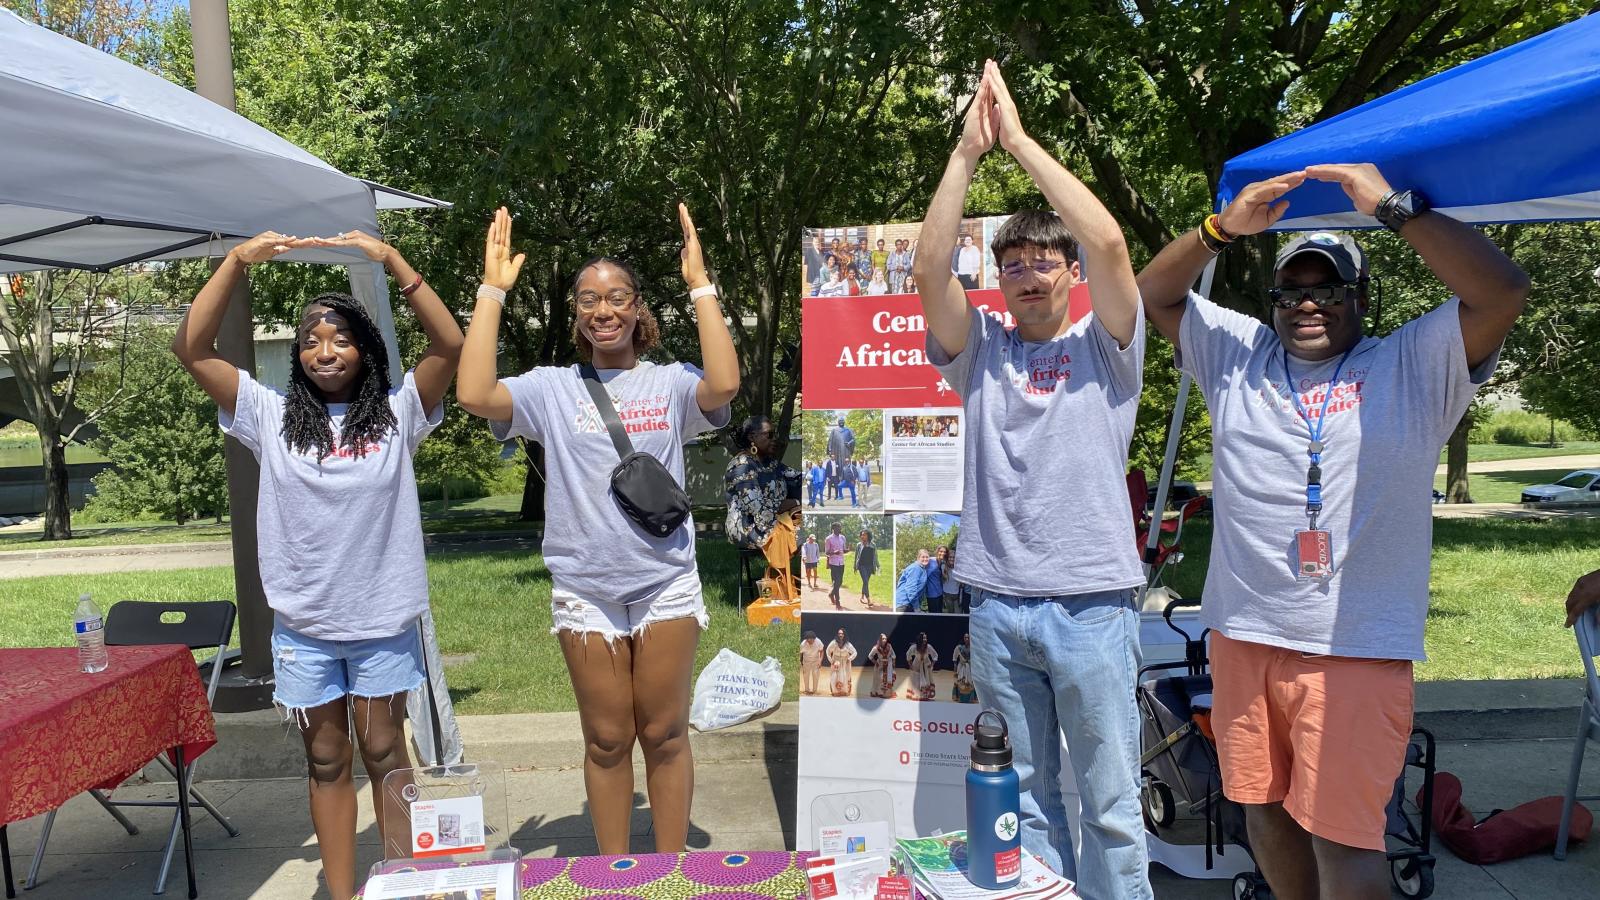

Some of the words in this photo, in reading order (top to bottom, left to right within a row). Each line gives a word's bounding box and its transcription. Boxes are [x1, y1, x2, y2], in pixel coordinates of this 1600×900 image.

[872, 311, 928, 333] Cen
[625, 419, 670, 434] tudies
[717, 674, 749, 684] THANK
[751, 677, 768, 689] YOU
[714, 685, 749, 696] THANK
[751, 688, 769, 700] YOU
[750, 699, 768, 711] YOU
[893, 719, 974, 735] cas.osu.e
